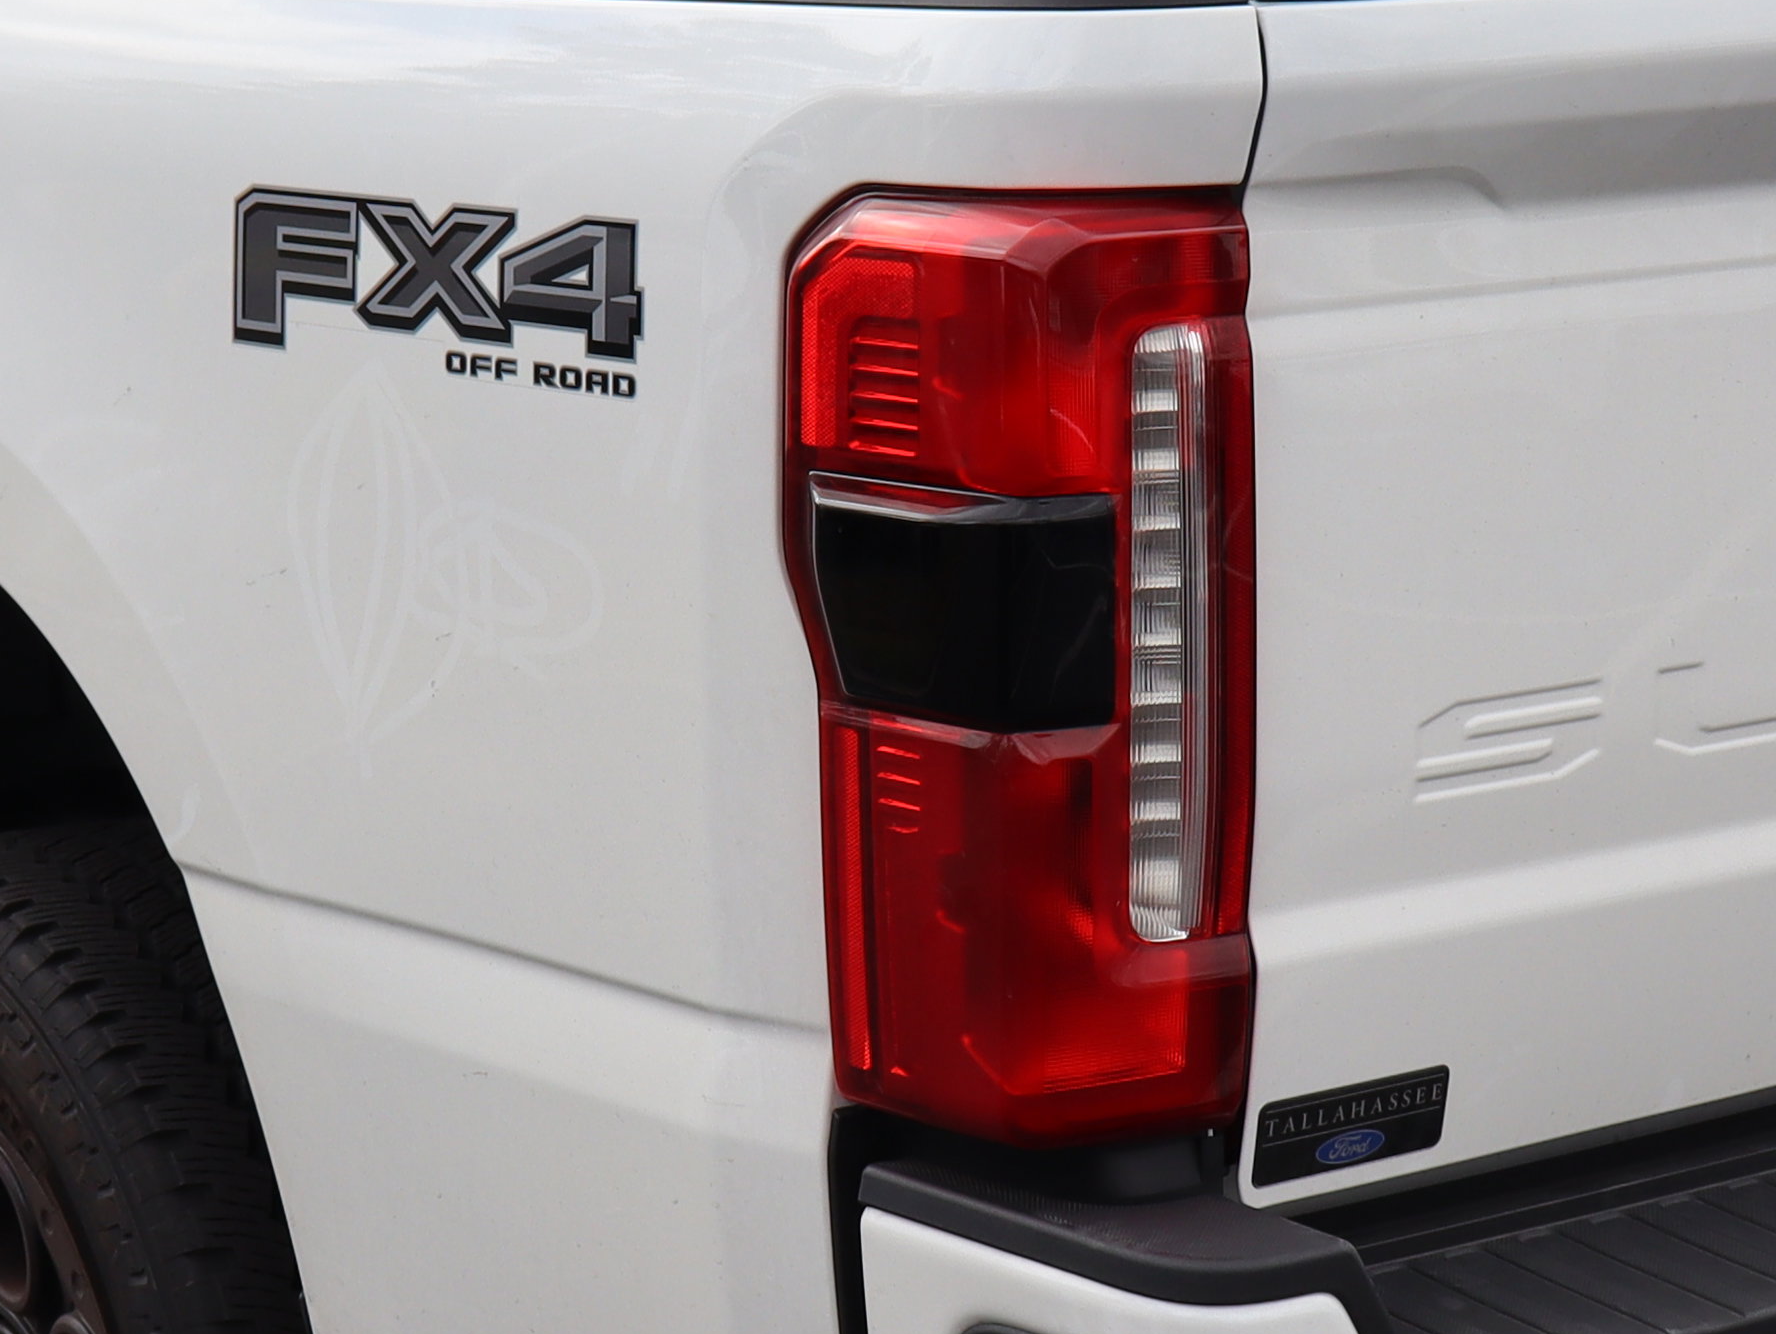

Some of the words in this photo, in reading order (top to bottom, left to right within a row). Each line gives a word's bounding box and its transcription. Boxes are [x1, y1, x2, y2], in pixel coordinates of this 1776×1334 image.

[232, 183, 644, 363] FX4
[445, 351, 519, 380] OFF
[533, 361, 637, 399] ROAD
[1265, 1083, 1443, 1138] TALLAHASSEE
[1328, 1135, 1371, 1160] Ford
